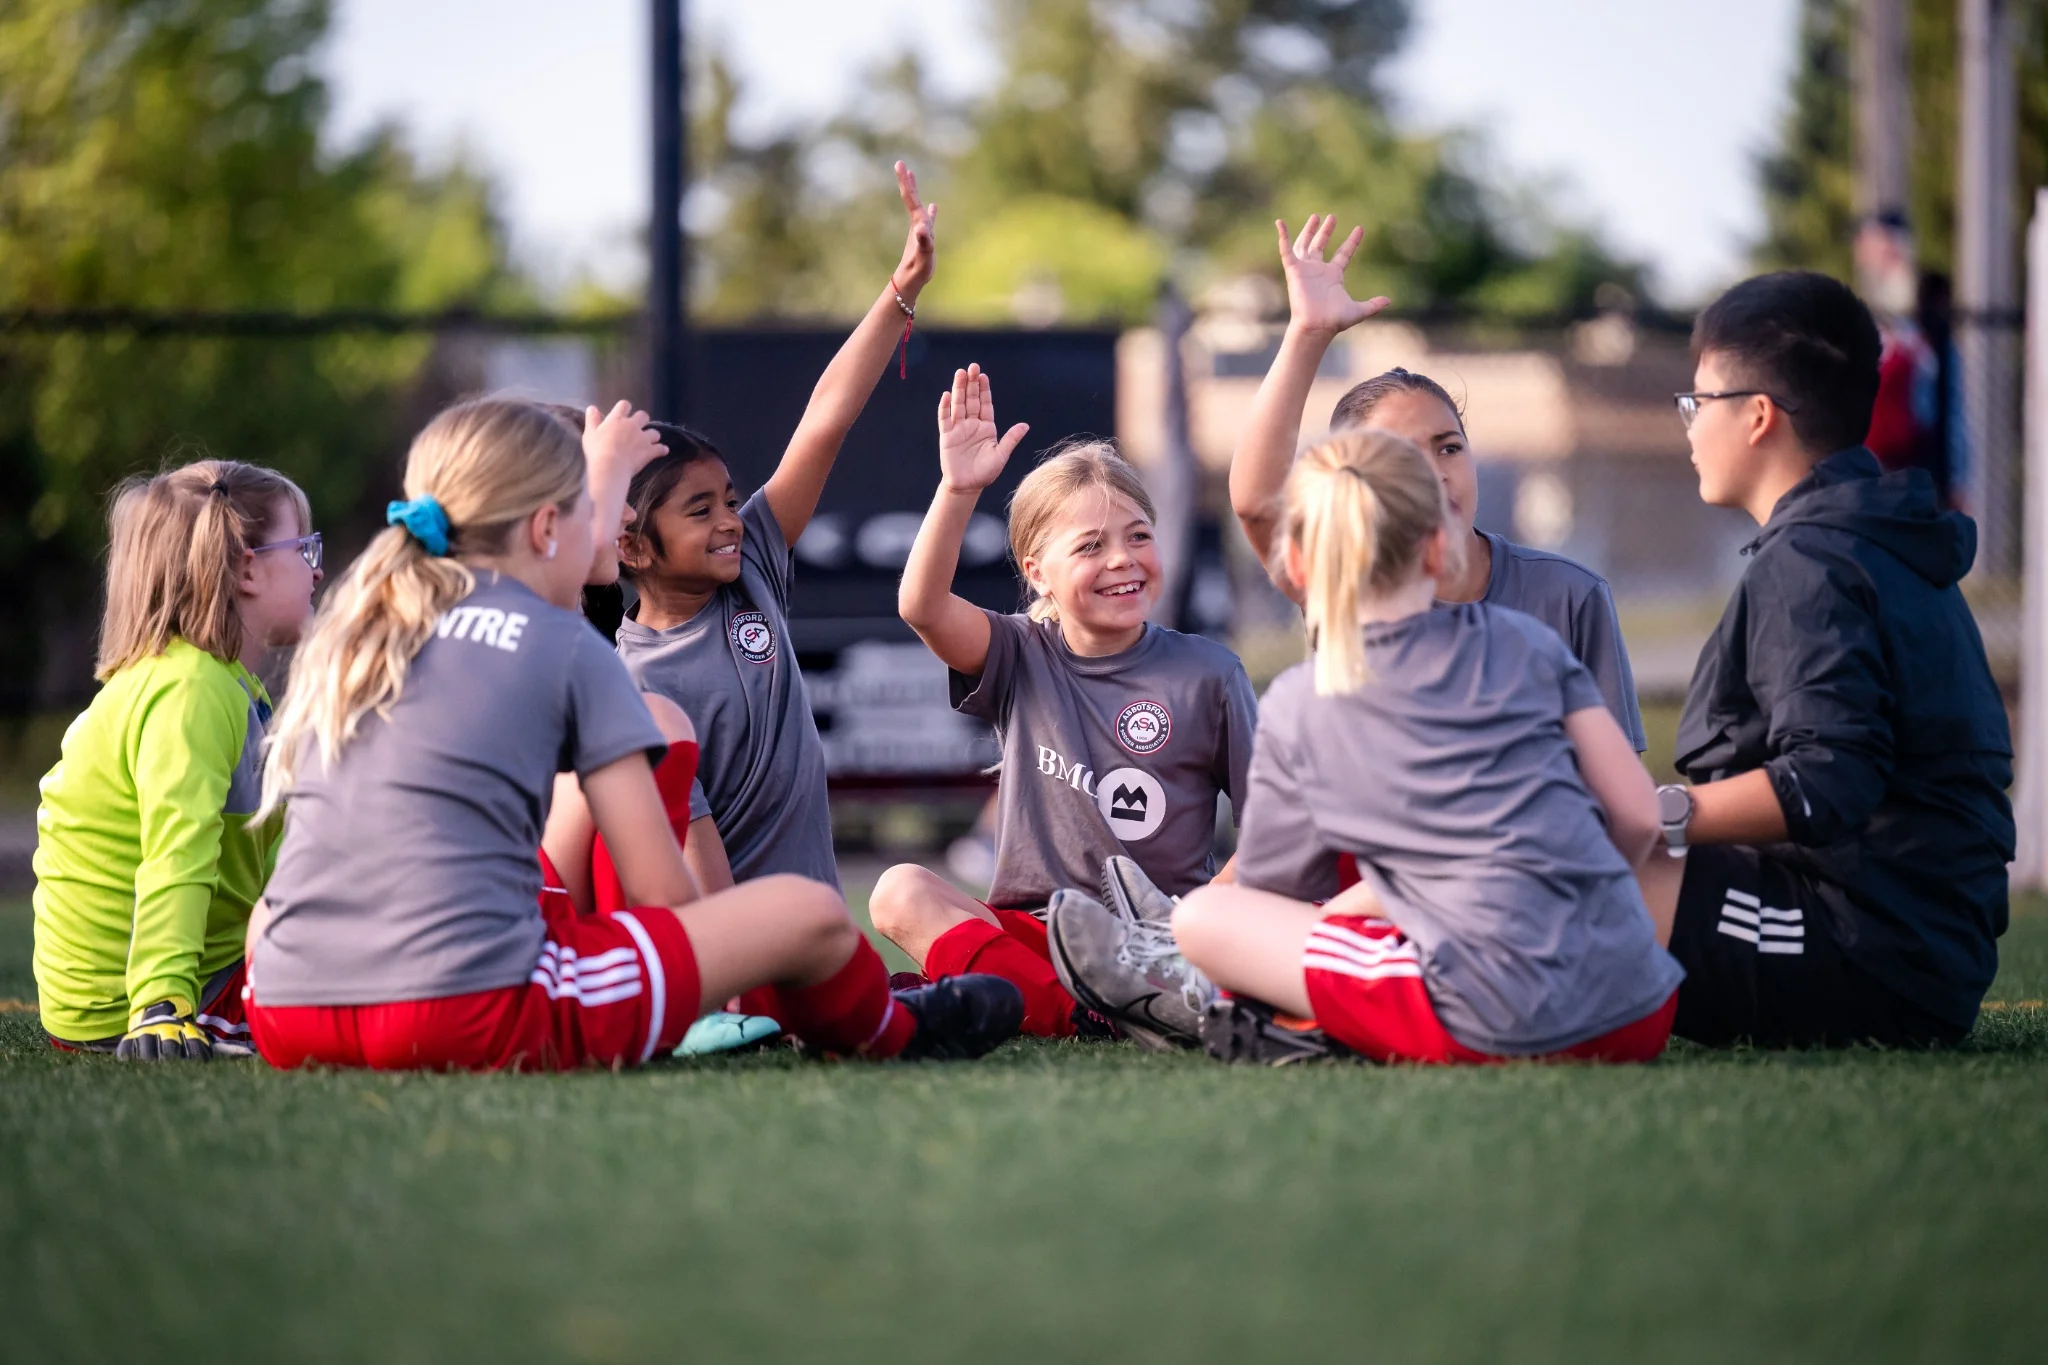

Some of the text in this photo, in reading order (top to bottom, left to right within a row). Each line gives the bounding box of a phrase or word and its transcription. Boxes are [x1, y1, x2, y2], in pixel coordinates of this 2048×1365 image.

[744, 627, 766, 648] ASA
[1122, 703, 1168, 725] ABBOTSFORD
[1130, 717, 1157, 732] ASA
[1120, 729, 1166, 750] SOCCER ASSOCIATION
